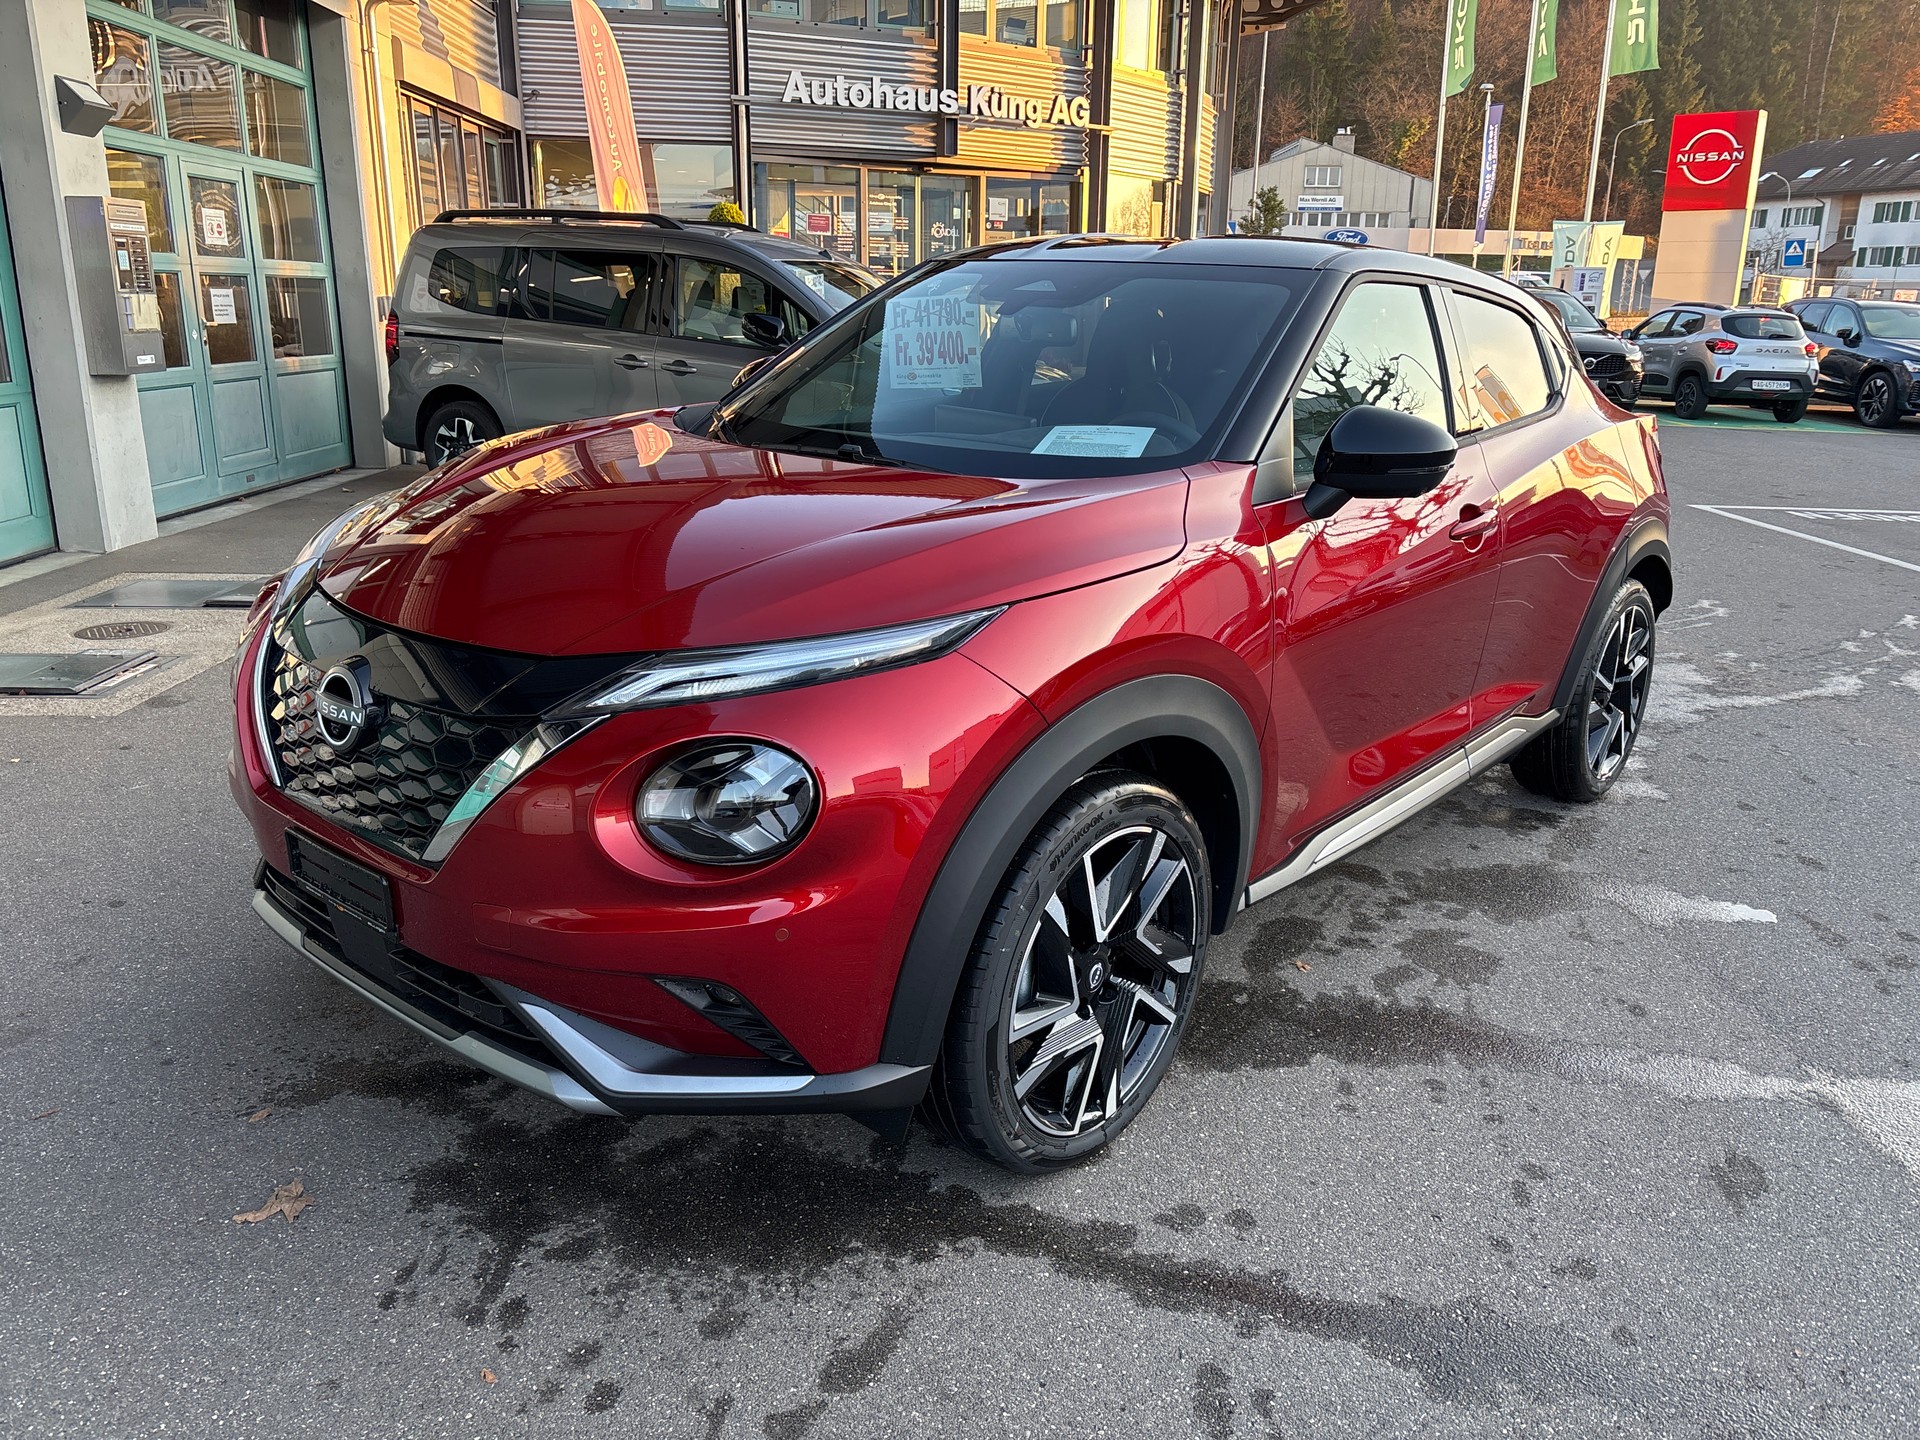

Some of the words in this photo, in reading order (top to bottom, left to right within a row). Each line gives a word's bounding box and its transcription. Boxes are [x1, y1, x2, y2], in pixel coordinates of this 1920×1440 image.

[782, 70, 959, 113] Autohaus
[967, 84, 1043, 127] Küng
[1050, 94, 1091, 127] AG
[1676, 150, 1745, 163] NISSAN
[1334, 231, 1362, 244] Ford
[892, 301, 911, 329] Fr.
[894, 333, 913, 367] Fr.
